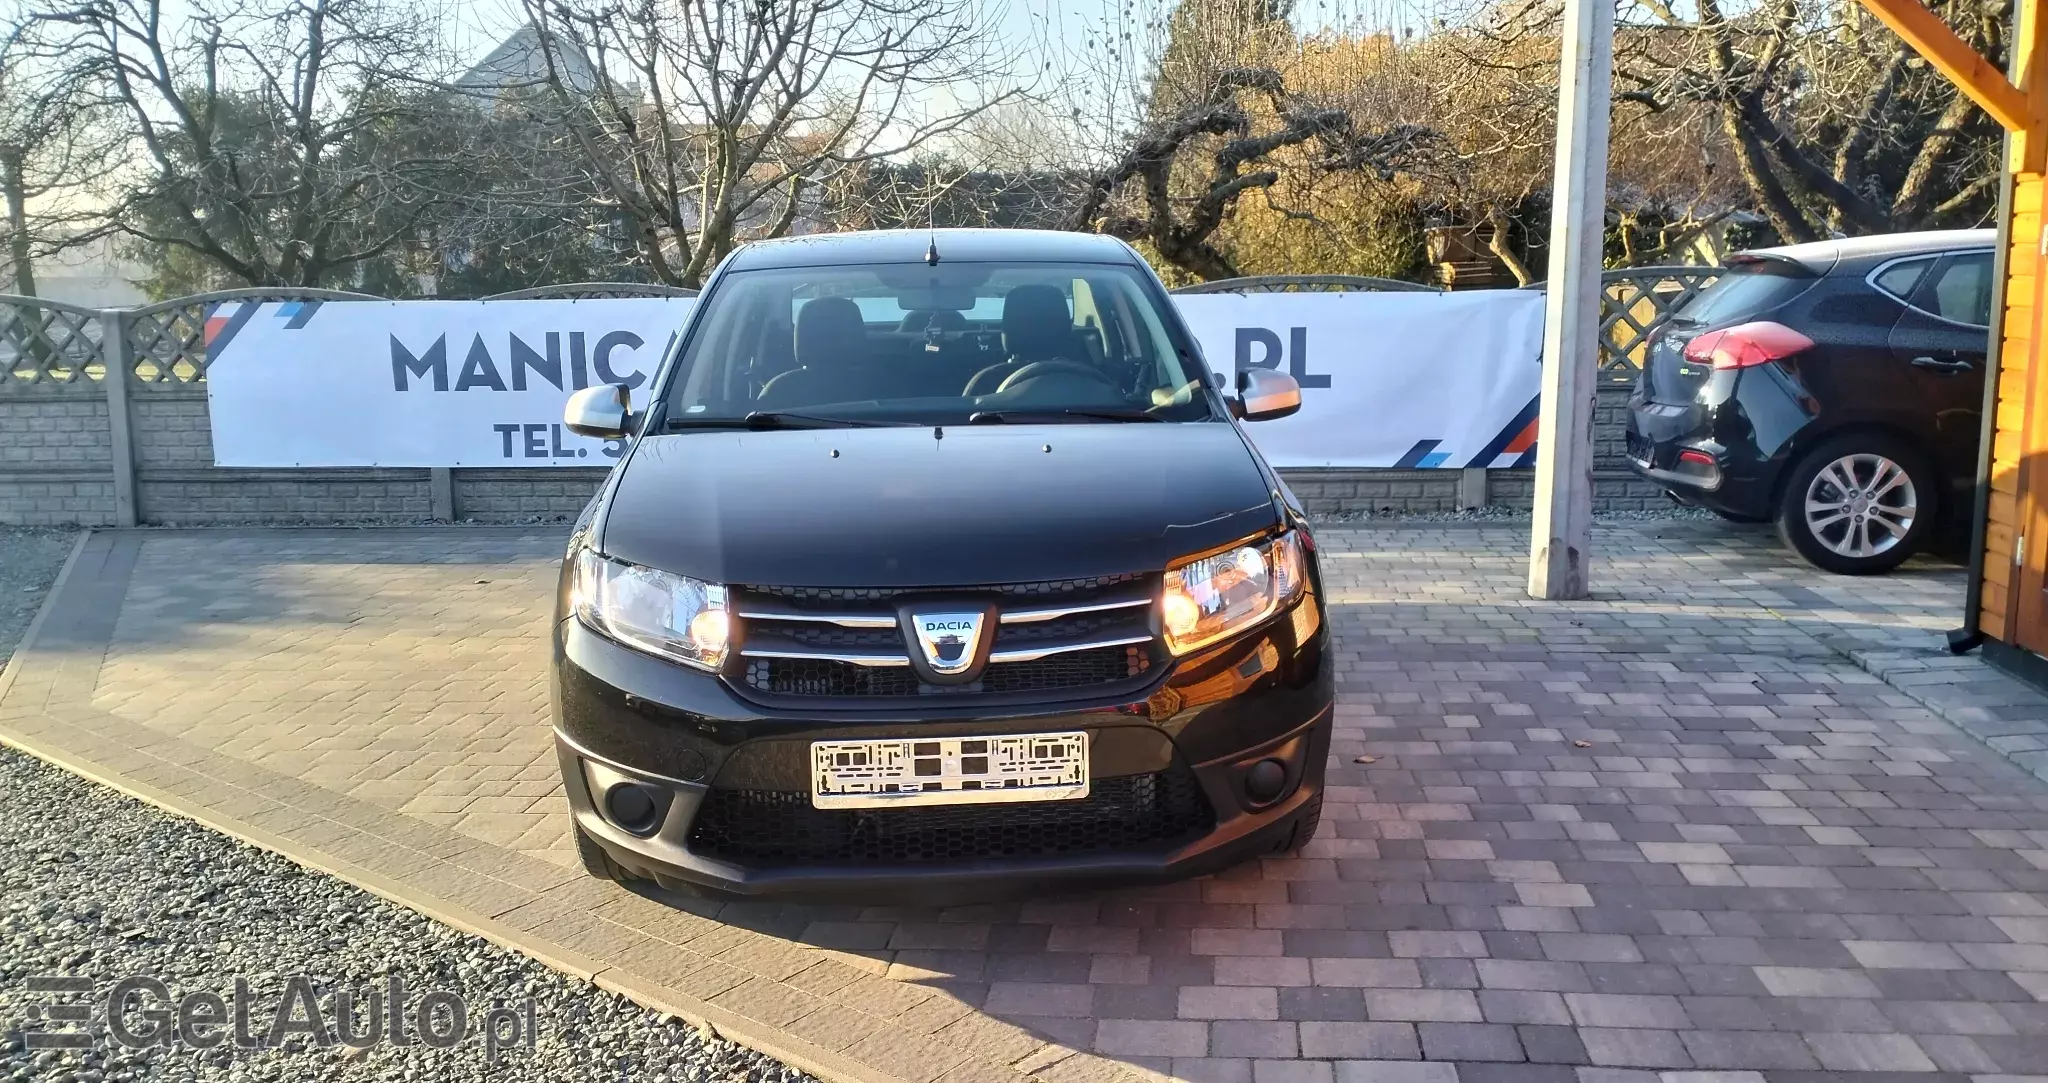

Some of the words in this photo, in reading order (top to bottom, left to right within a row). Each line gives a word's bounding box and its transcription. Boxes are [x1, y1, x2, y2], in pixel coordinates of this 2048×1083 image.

[390, 331, 676, 391] MANIC
[494, 423, 588, 458] TEL.
[926, 621, 972, 631] DACIA
